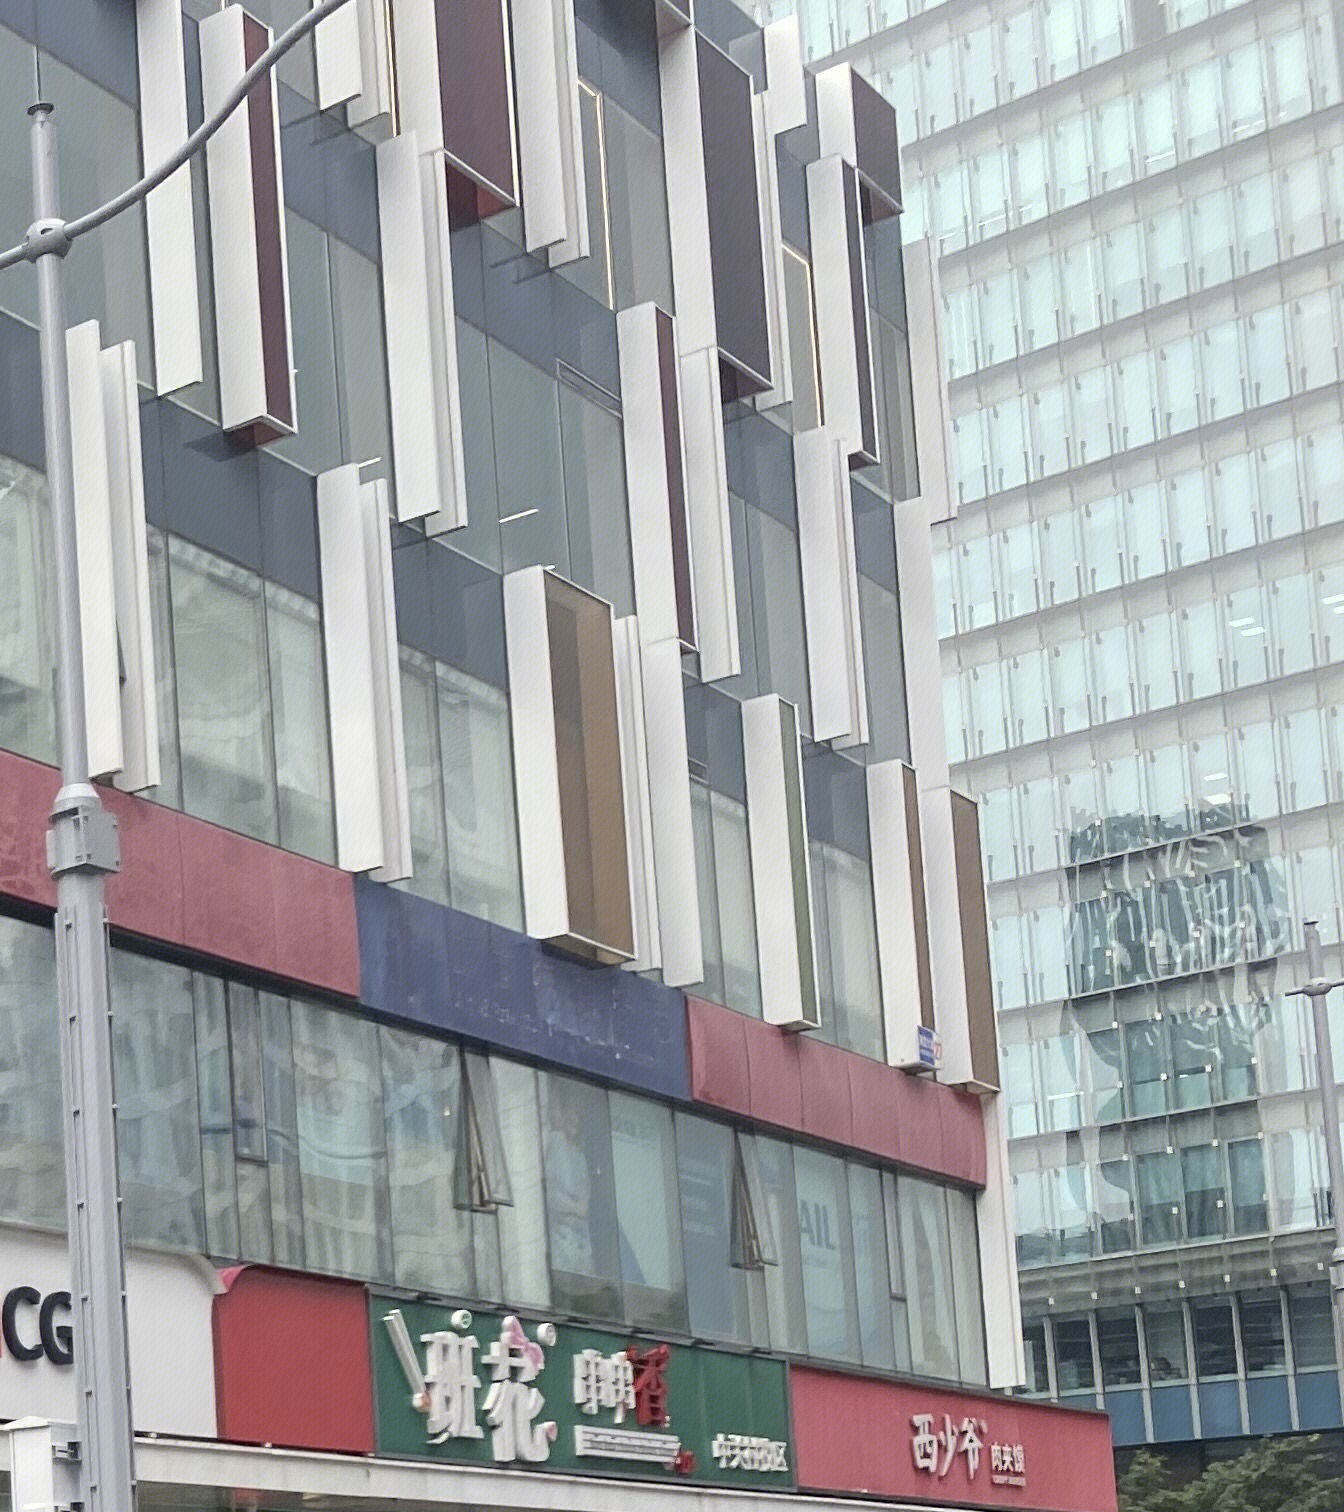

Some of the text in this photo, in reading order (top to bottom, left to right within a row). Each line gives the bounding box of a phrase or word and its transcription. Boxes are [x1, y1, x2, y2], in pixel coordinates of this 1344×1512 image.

[912, 1413, 989, 1480] 西少爷
[991, 1441, 1026, 1474] 肉夹馍
